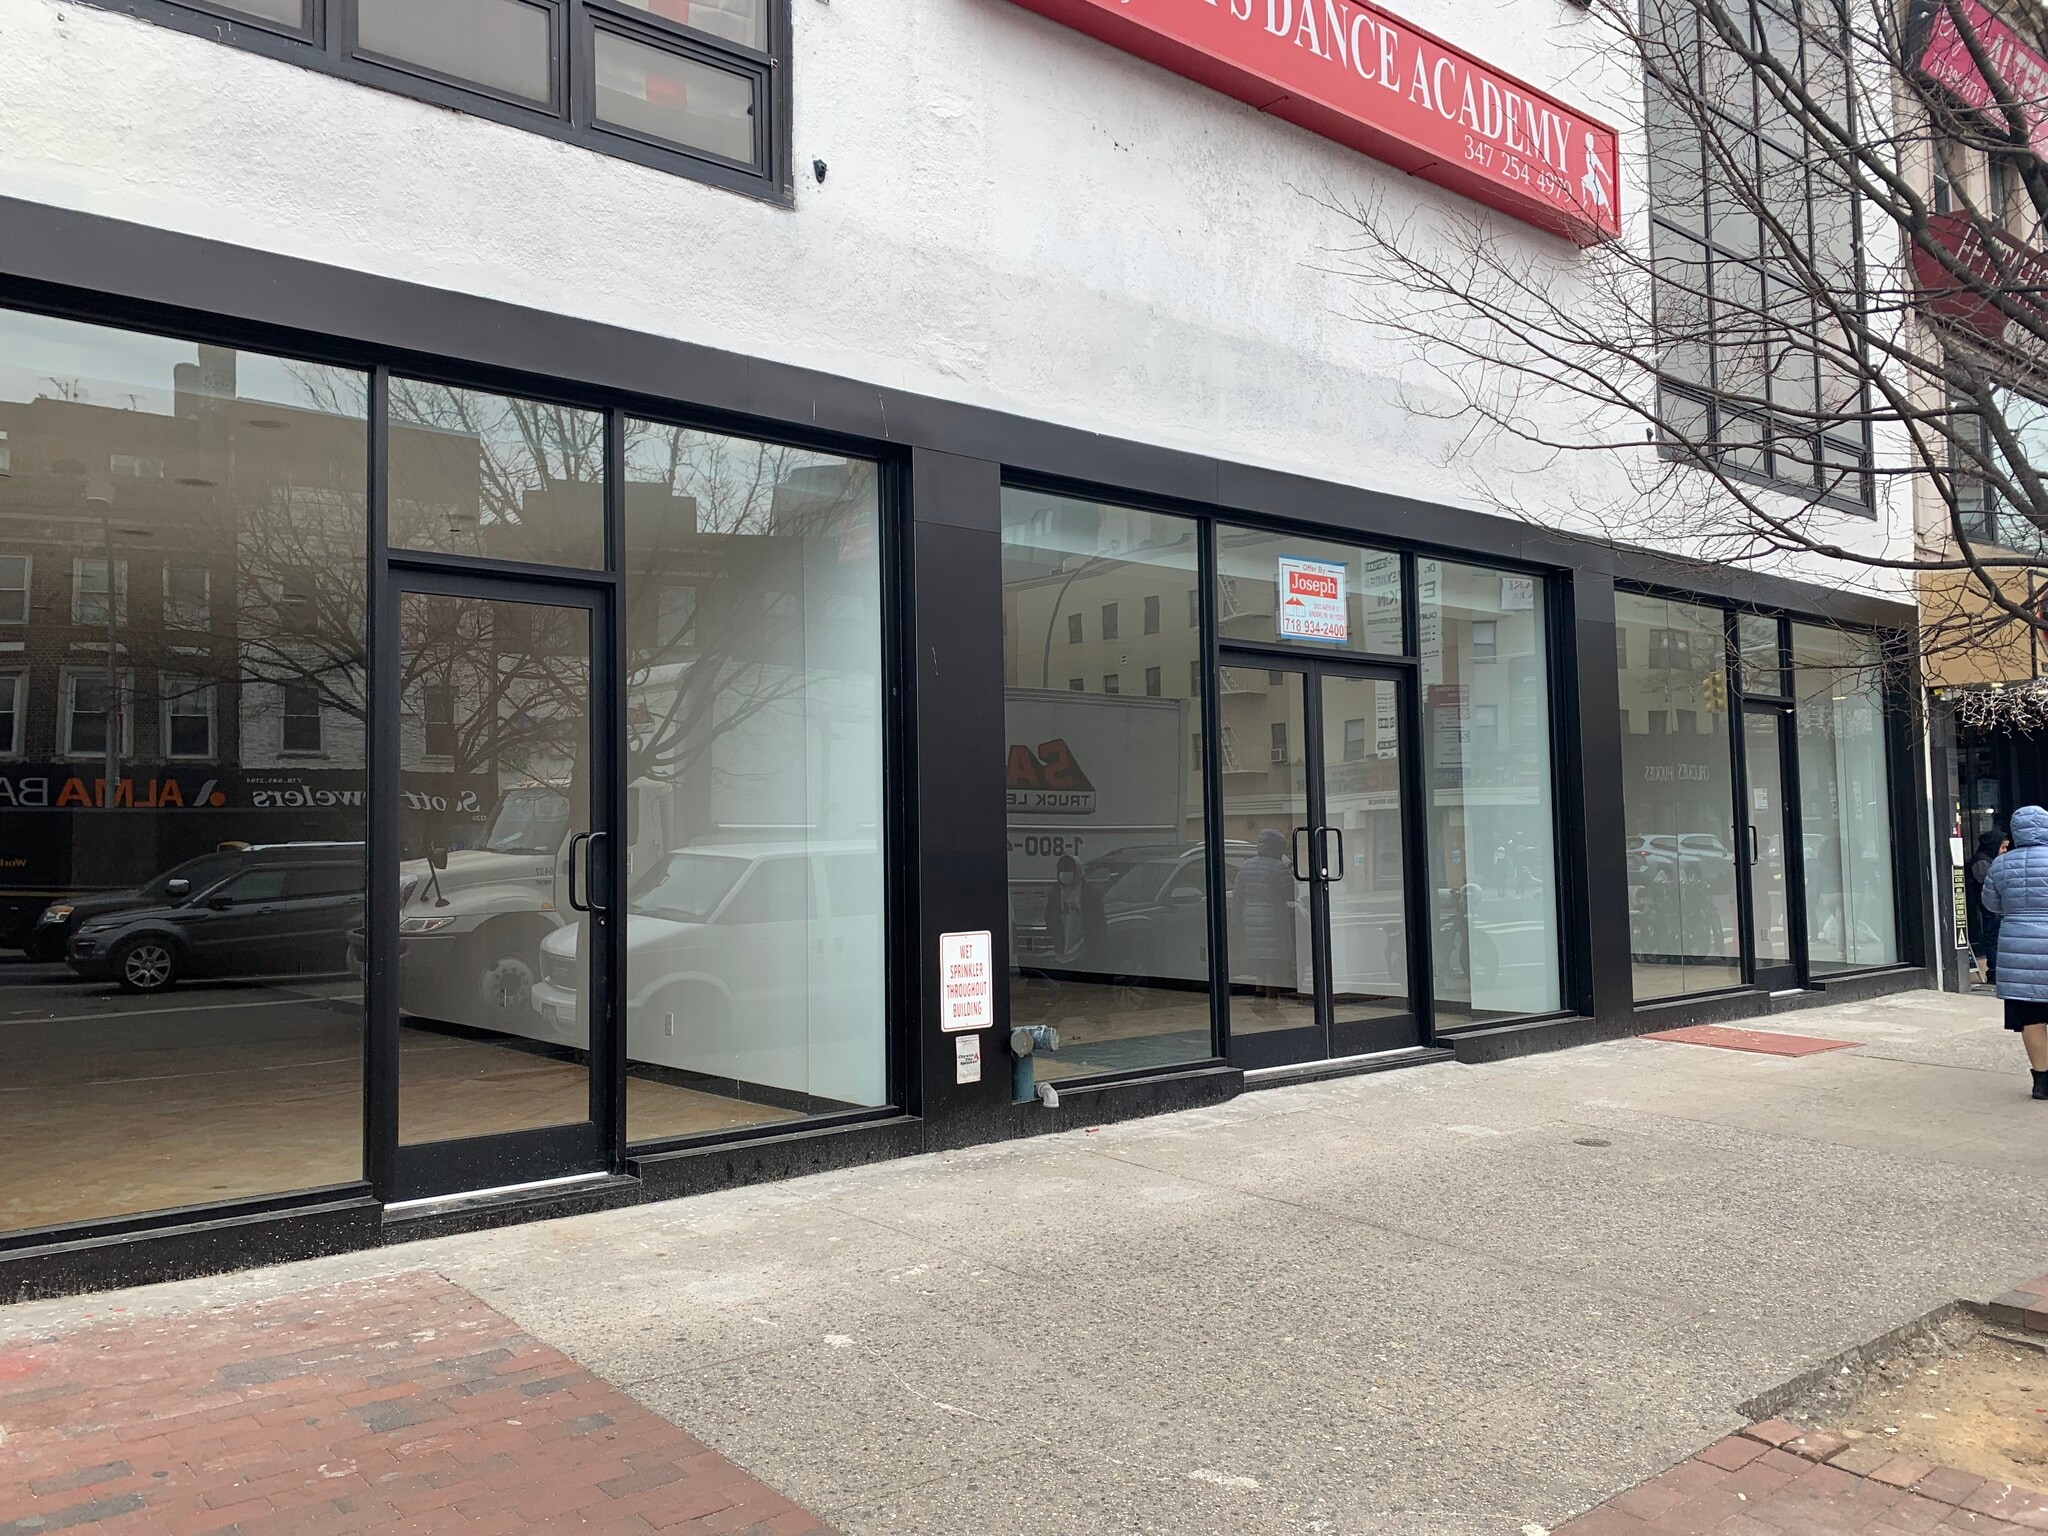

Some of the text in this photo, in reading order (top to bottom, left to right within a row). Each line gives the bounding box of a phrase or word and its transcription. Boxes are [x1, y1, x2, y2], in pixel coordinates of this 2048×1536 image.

[1263, 0, 1572, 174] DANCE ACADEMY
[1464, 133, 1495, 168] 347
[1501, 151, 1530, 186] 254
[1292, 573, 1337, 597] Joseph
[1285, 618, 1345, 637] 718 934-2400
[960, 944, 972, 959] WET
[950, 962, 984, 979] SPRINKLER
[947, 981, 987, 999] THROUGHOUT
[953, 1001, 982, 1018] BUILDING
